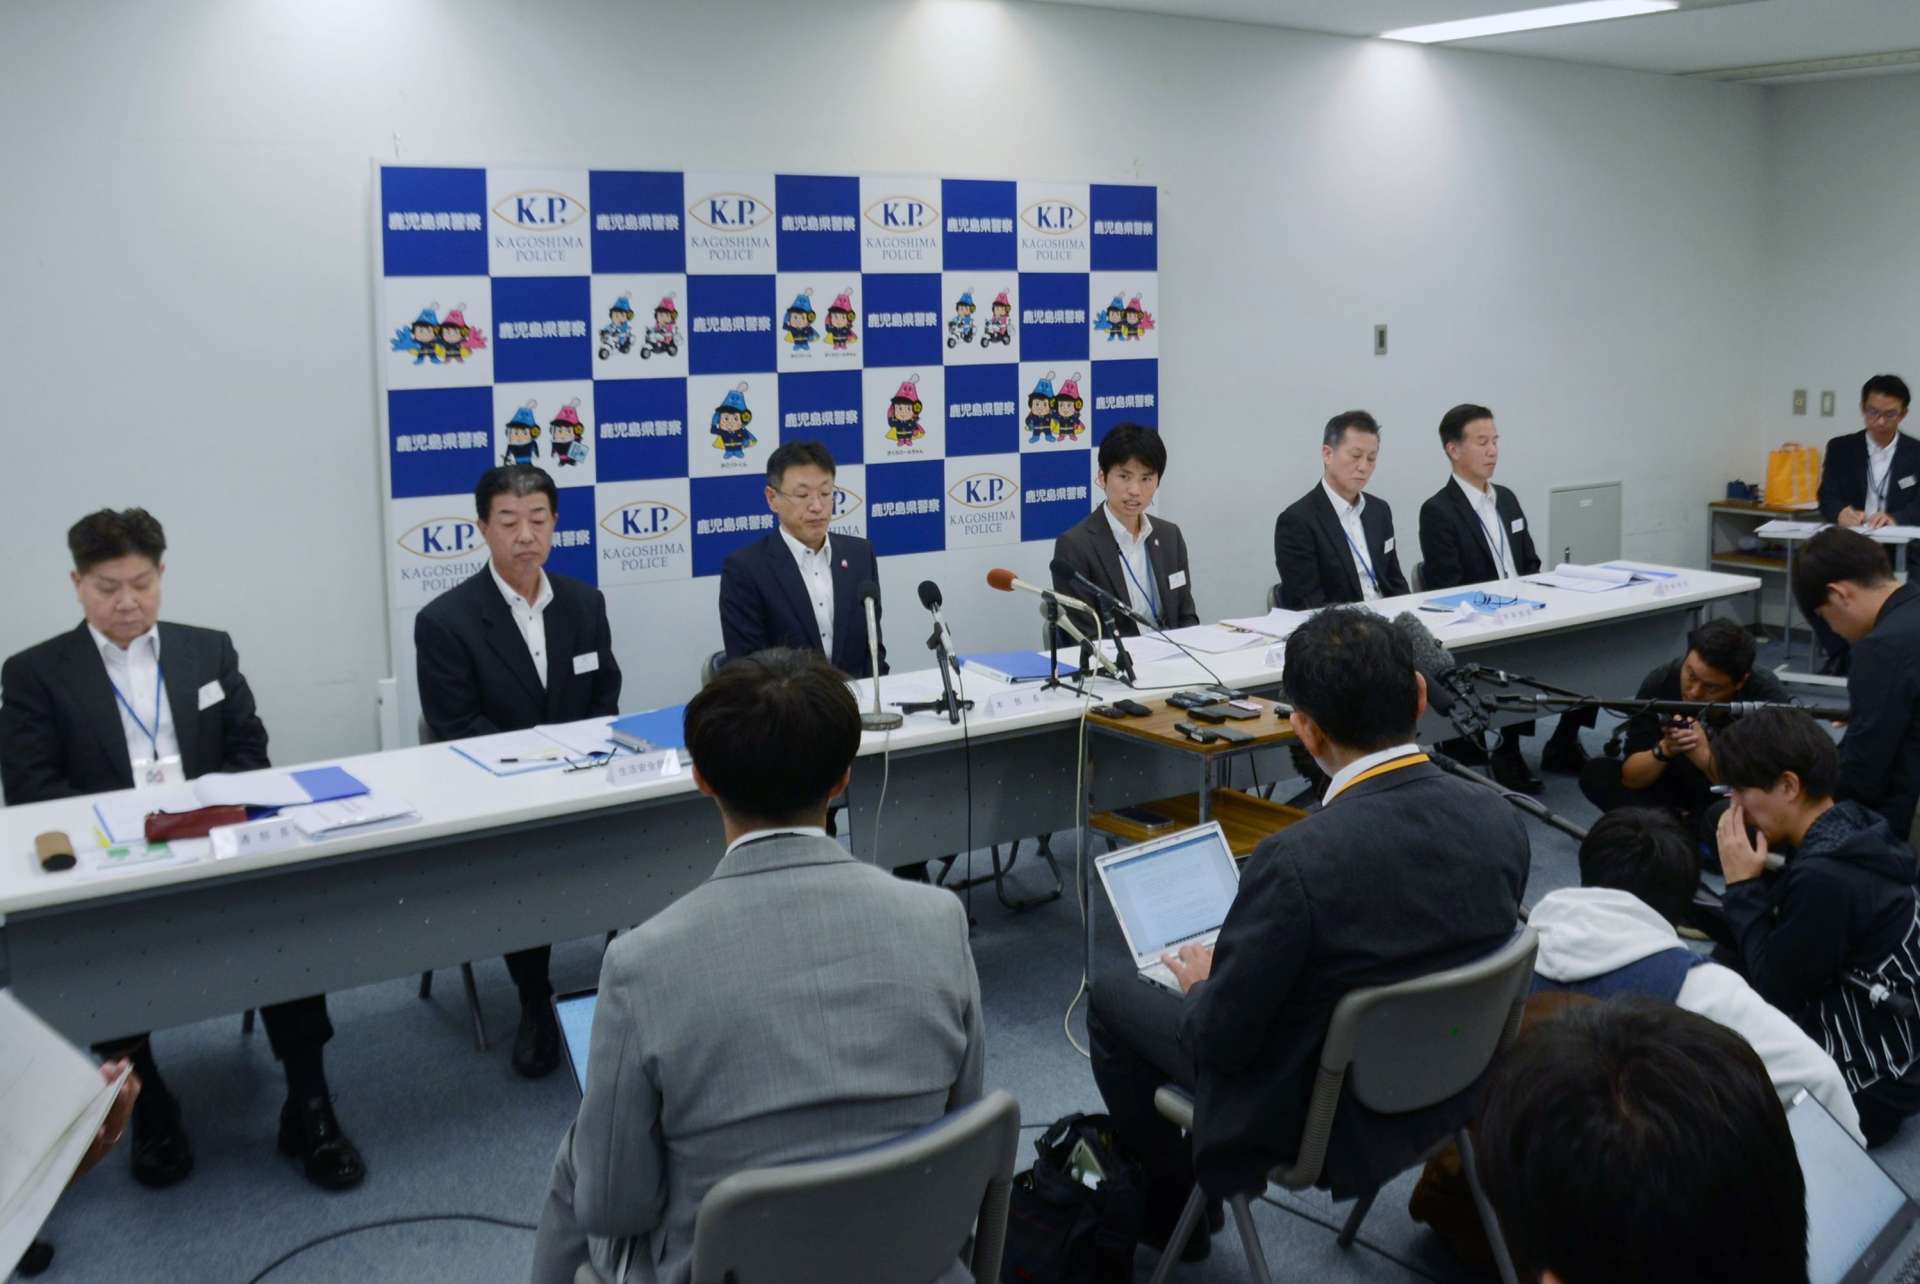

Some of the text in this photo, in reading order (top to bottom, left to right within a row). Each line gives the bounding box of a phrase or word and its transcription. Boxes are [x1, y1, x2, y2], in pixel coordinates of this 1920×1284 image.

[516, 197, 567, 224] K.P.
[710, 199, 755, 225] K.P.
[883, 203, 923, 226] K.P.
[1037, 206, 1073, 228] K.P.
[782, 216, 855, 231] 鹿児島県警察
[947, 217, 1013, 233] 鹿児島県警察
[1094, 221, 1153, 235] 鹿児島県警察
[496, 237, 583, 249] KAGOSHIMA
[690, 237, 770, 248] KAGOSHIMA
[866, 238, 937, 249] KAGOSHIMA
[1021, 239, 1085, 249] KAGOSHIMA
[516, 250, 566, 262] POLICE
[709, 250, 754, 260] POLICE
[881, 250, 923, 260] POLICE
[1036, 250, 1072, 260] POLICE
[693, 316, 771, 332] 鹿児島県警察
[868, 312, 937, 328] 鹿児島県警察
[1023, 310, 1085, 324] 鹿児島県警察
[499, 320, 587, 340] 鹿児島県警察
[950, 401, 1015, 417] 鹿児島県警察
[1096, 394, 1154, 409] 鹿児島県警察
[785, 410, 858, 427] 鹿児島県警察
[600, 420, 681, 438] 鹿児島県警察
[397, 431, 487, 452] 鹿児島県警察
[965, 478, 1004, 503] K.P.
[1026, 486, 1086, 503] 鹿児島県警察
[872, 499, 939, 517] 鹿児島県警察
[621, 506, 669, 535] K.P.
[697, 514, 774, 534] 鹿児島県警察
[950, 511, 1016, 526] KAGOSHIMA
[965, 523, 1002, 535] POLICE
[422, 523, 475, 554] K.P.
[602, 543, 685, 560] KAGOSHIMA
[400, 562, 483, 580] KAGOSHIM
[621, 557, 668, 571] POLICE
